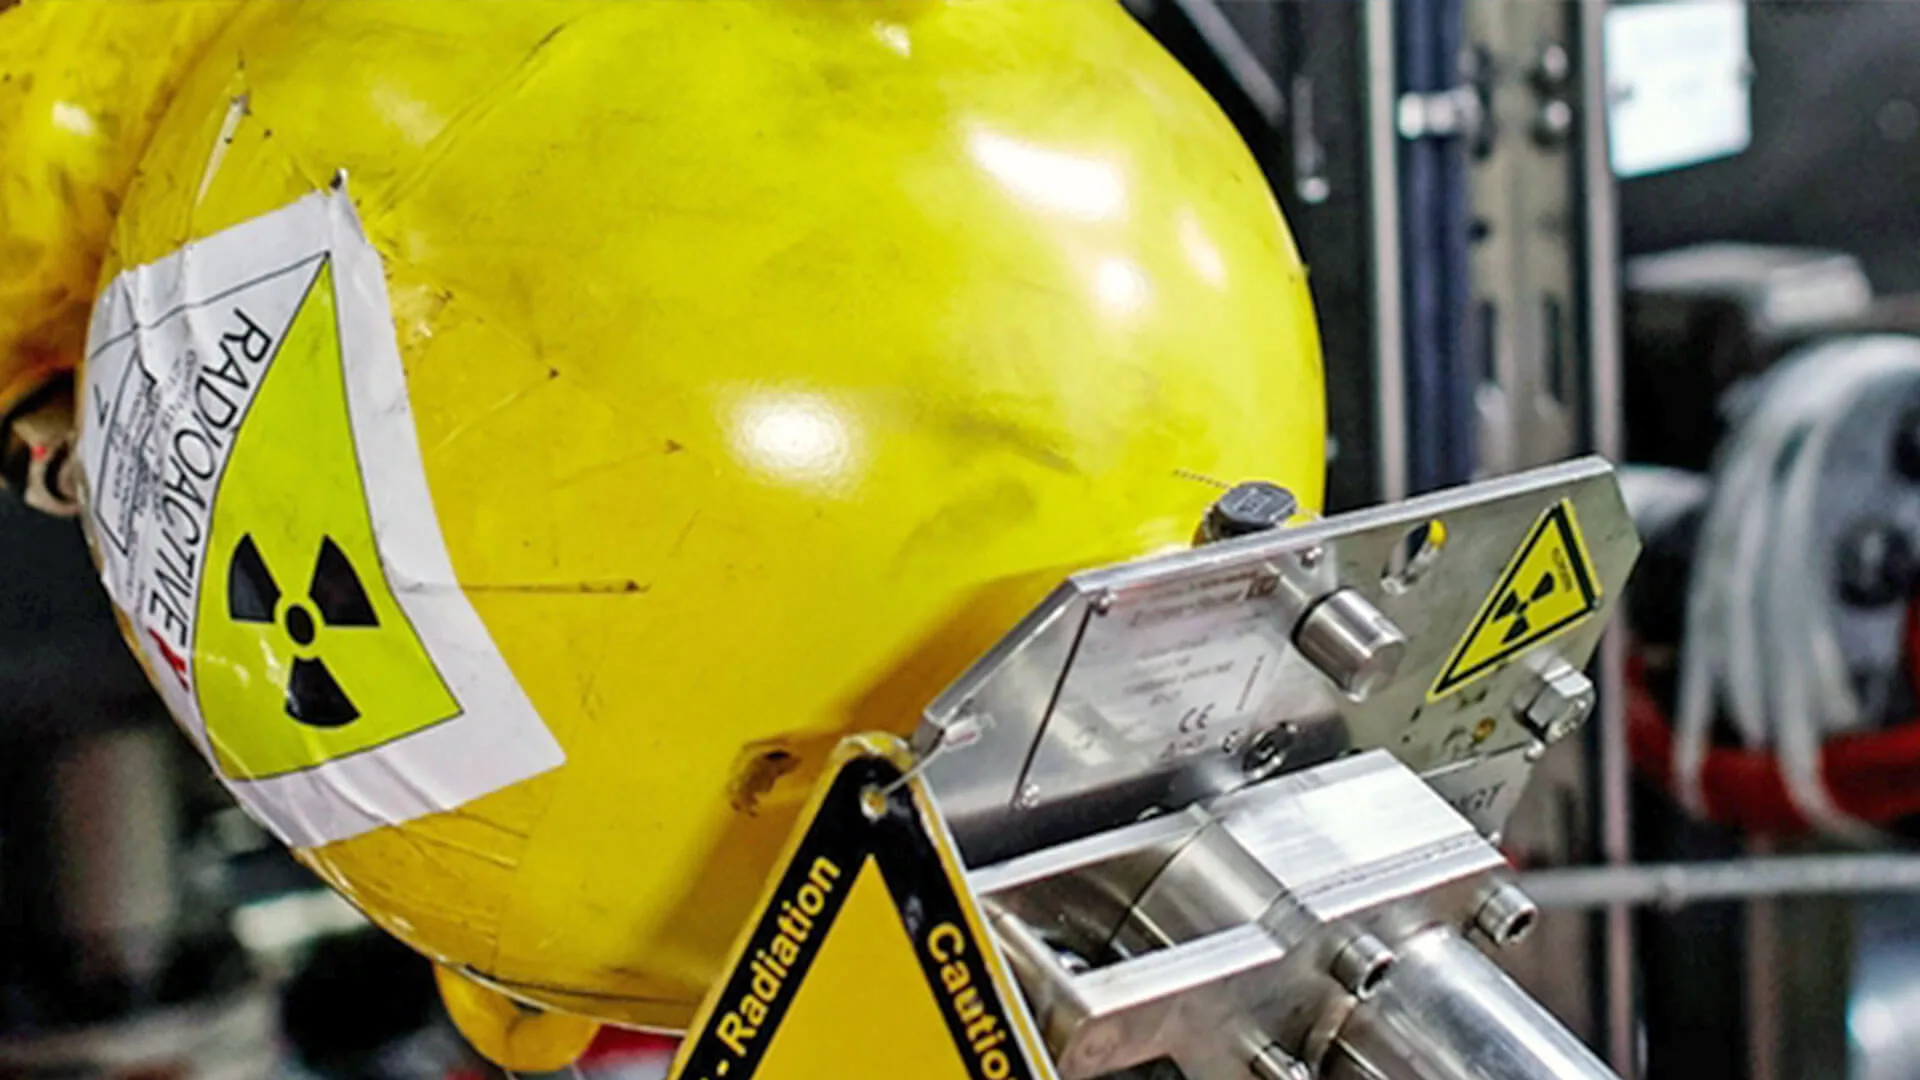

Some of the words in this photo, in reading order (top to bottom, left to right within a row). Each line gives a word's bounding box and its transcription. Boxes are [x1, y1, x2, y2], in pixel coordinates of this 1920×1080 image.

[149, 307, 272, 646] RADIOACTIVE
[716, 856, 841, 1057] Radiation
[927, 921, 1016, 1080] Cautio
